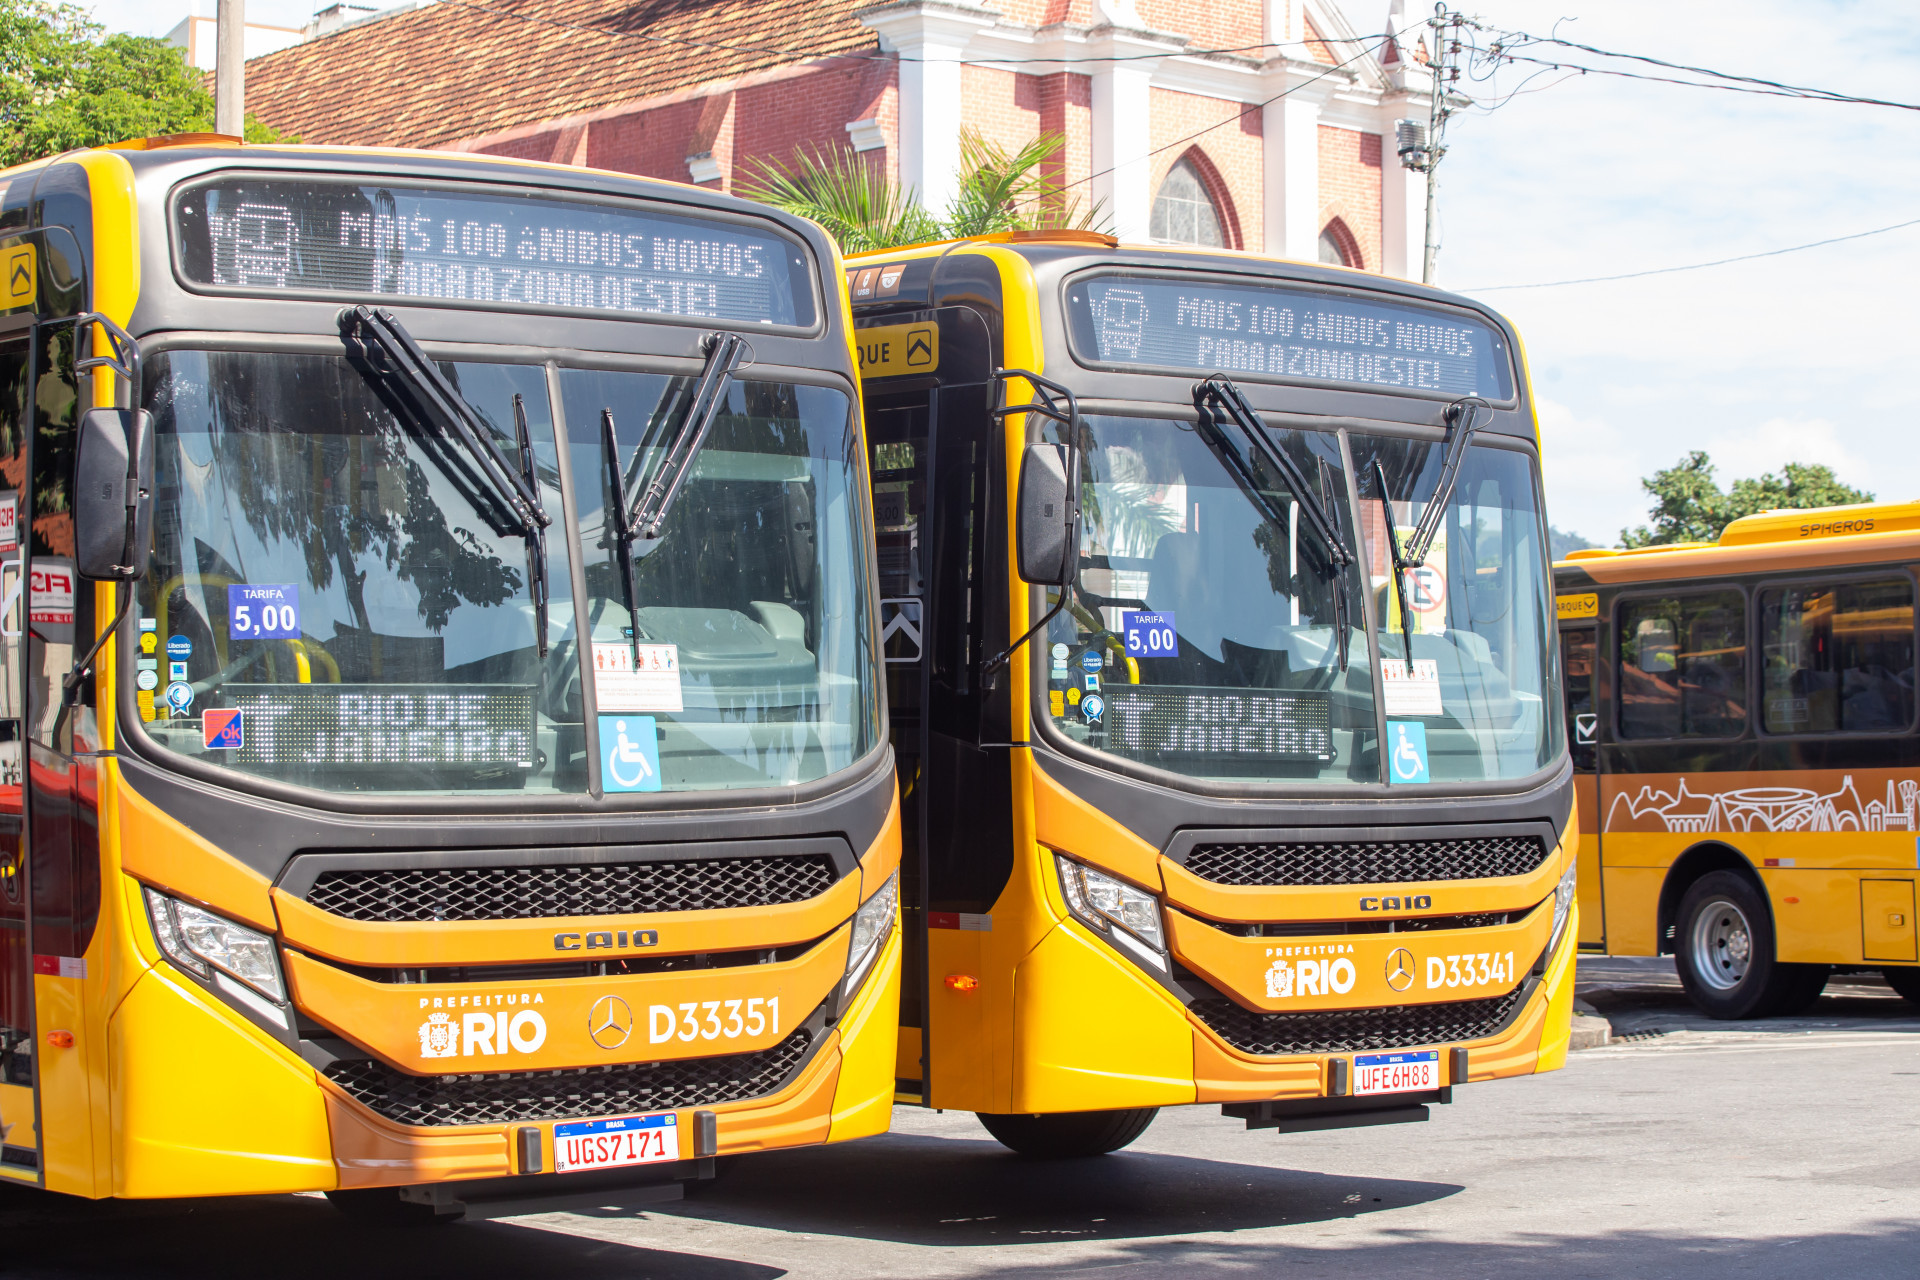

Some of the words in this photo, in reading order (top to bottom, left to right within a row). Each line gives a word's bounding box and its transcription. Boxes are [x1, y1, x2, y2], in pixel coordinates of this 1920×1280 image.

[341, 211, 431, 252] MAIS
[442, 220, 506, 257] 100
[653, 237, 763, 278] NOVOS
[857, 288, 870, 296] USB
[1177, 296, 1241, 331] MAIS
[1249, 304, 1294, 337] 100
[1395, 321, 1474, 357] NOVOS
[1198, 336, 1264, 371] PARA
[1288, 346, 1355, 380] ZONA
[1358, 353, 1440, 389] OESTE!
[1800, 518, 1875, 537] SPHEROS
[243, 589, 284, 599] TARIFA
[235, 605, 296, 635] 5,00
[1134, 616, 1165, 624] TARIFA
[1129, 628, 1174, 654] 5,00
[1188, 695, 1242, 722] RIO
[1252, 696, 1296, 724] DE
[221, 724, 241, 740] ok
[1359, 895, 1432, 912] CAIO
[554, 929, 659, 951] CAIO
[1266, 944, 1354, 957] PREFEITURA
[1296, 957, 1356, 996] RIO
[1426, 951, 1514, 990] D33341
[419, 992, 544, 1009] PREFEITURA
[462, 1009, 547, 1057] RIO
[649, 996, 779, 1045] D33351
[1362, 1064, 1429, 1090] UFE6H88
[605, 1120, 626, 1129] BRASIL
[567, 1130, 666, 1165] UGS7I71
